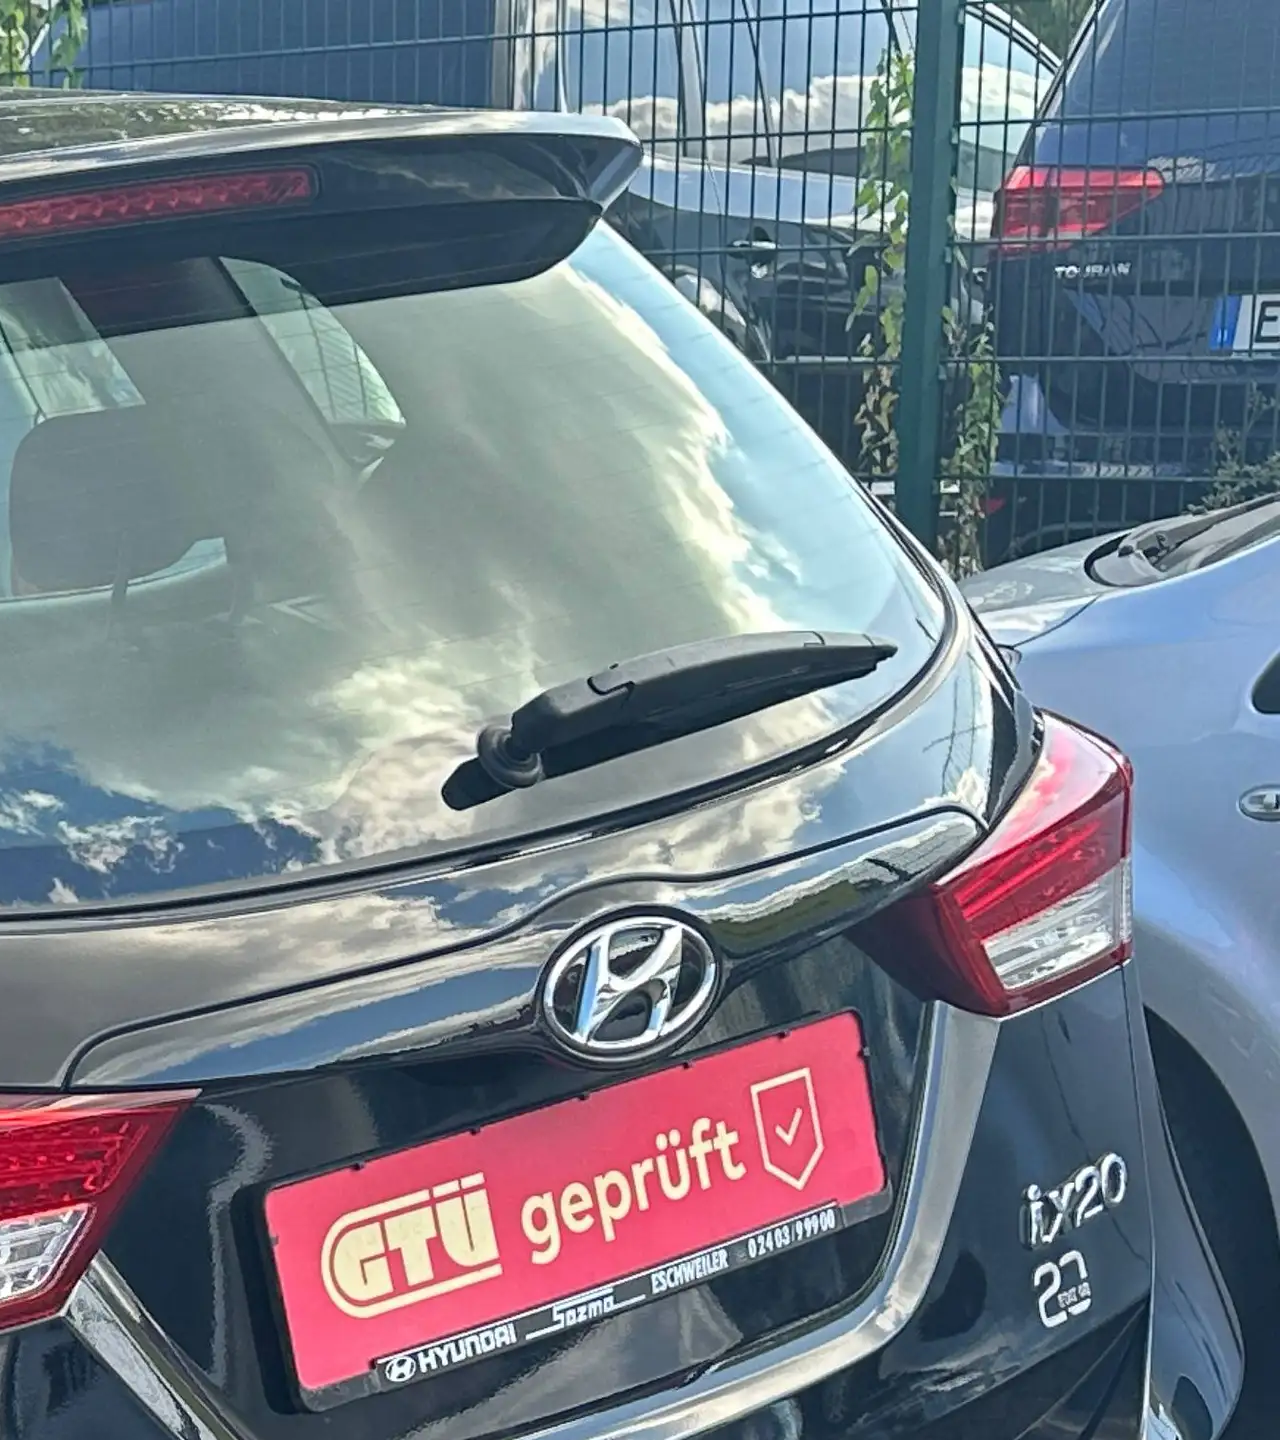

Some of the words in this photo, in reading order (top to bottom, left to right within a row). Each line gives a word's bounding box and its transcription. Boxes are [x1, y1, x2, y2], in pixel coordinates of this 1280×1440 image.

[332, 1172, 500, 1302] GTÜ
[521, 1117, 747, 1264] geprüft
[418, 1323, 518, 1374] HYUNDAI
[650, 1249, 730, 1294] ESCHWEILER
